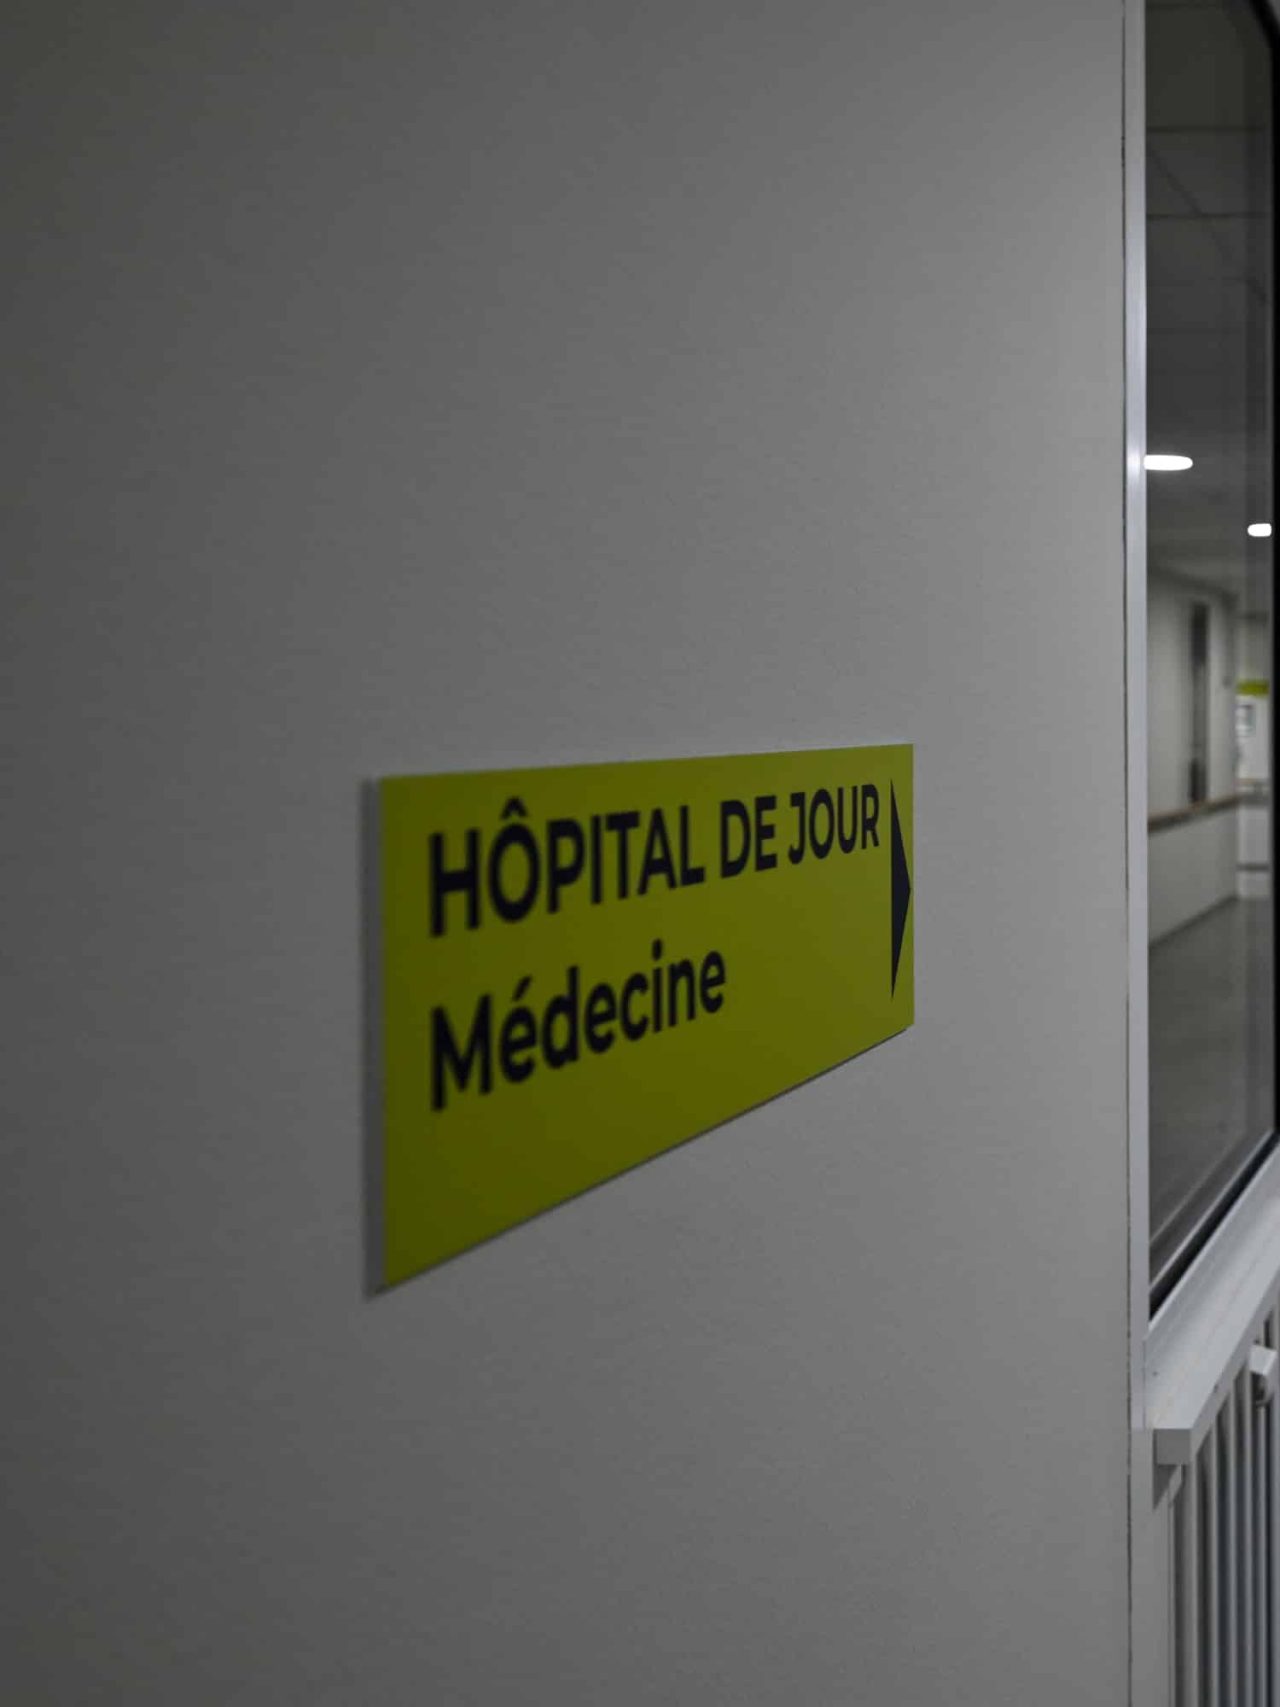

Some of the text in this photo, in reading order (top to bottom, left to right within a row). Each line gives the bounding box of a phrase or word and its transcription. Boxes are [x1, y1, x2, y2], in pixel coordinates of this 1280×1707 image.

[428, 784, 880, 938] HÔPITAL DE JOUR
[430, 939, 726, 1113] Médecine
